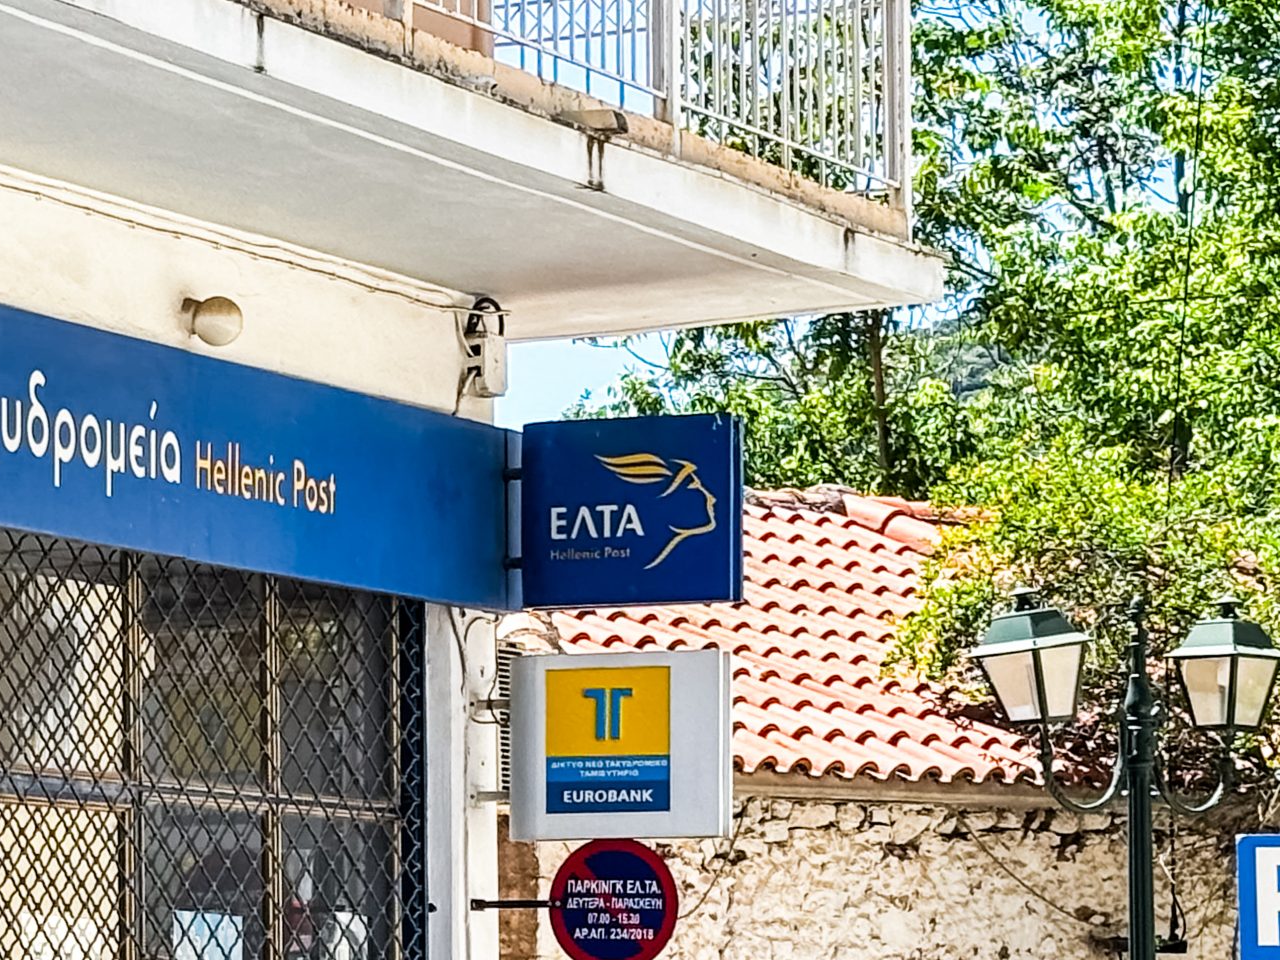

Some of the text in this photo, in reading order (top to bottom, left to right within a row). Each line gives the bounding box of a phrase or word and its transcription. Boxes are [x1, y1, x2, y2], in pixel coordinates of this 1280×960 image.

[195, 441, 336, 515] Hellenic Post
[550, 504, 645, 540] ΕΛΤΑ
[550, 547, 630, 561] Hellenic Post
[563, 789, 653, 803] EUROBANK
[567, 879, 624, 894] ΠΑΡΚΙΝΓΚ
[566, 897, 605, 909] ΔΕΥΤΕΡΑ
[609, 928, 654, 940] 234/2018
